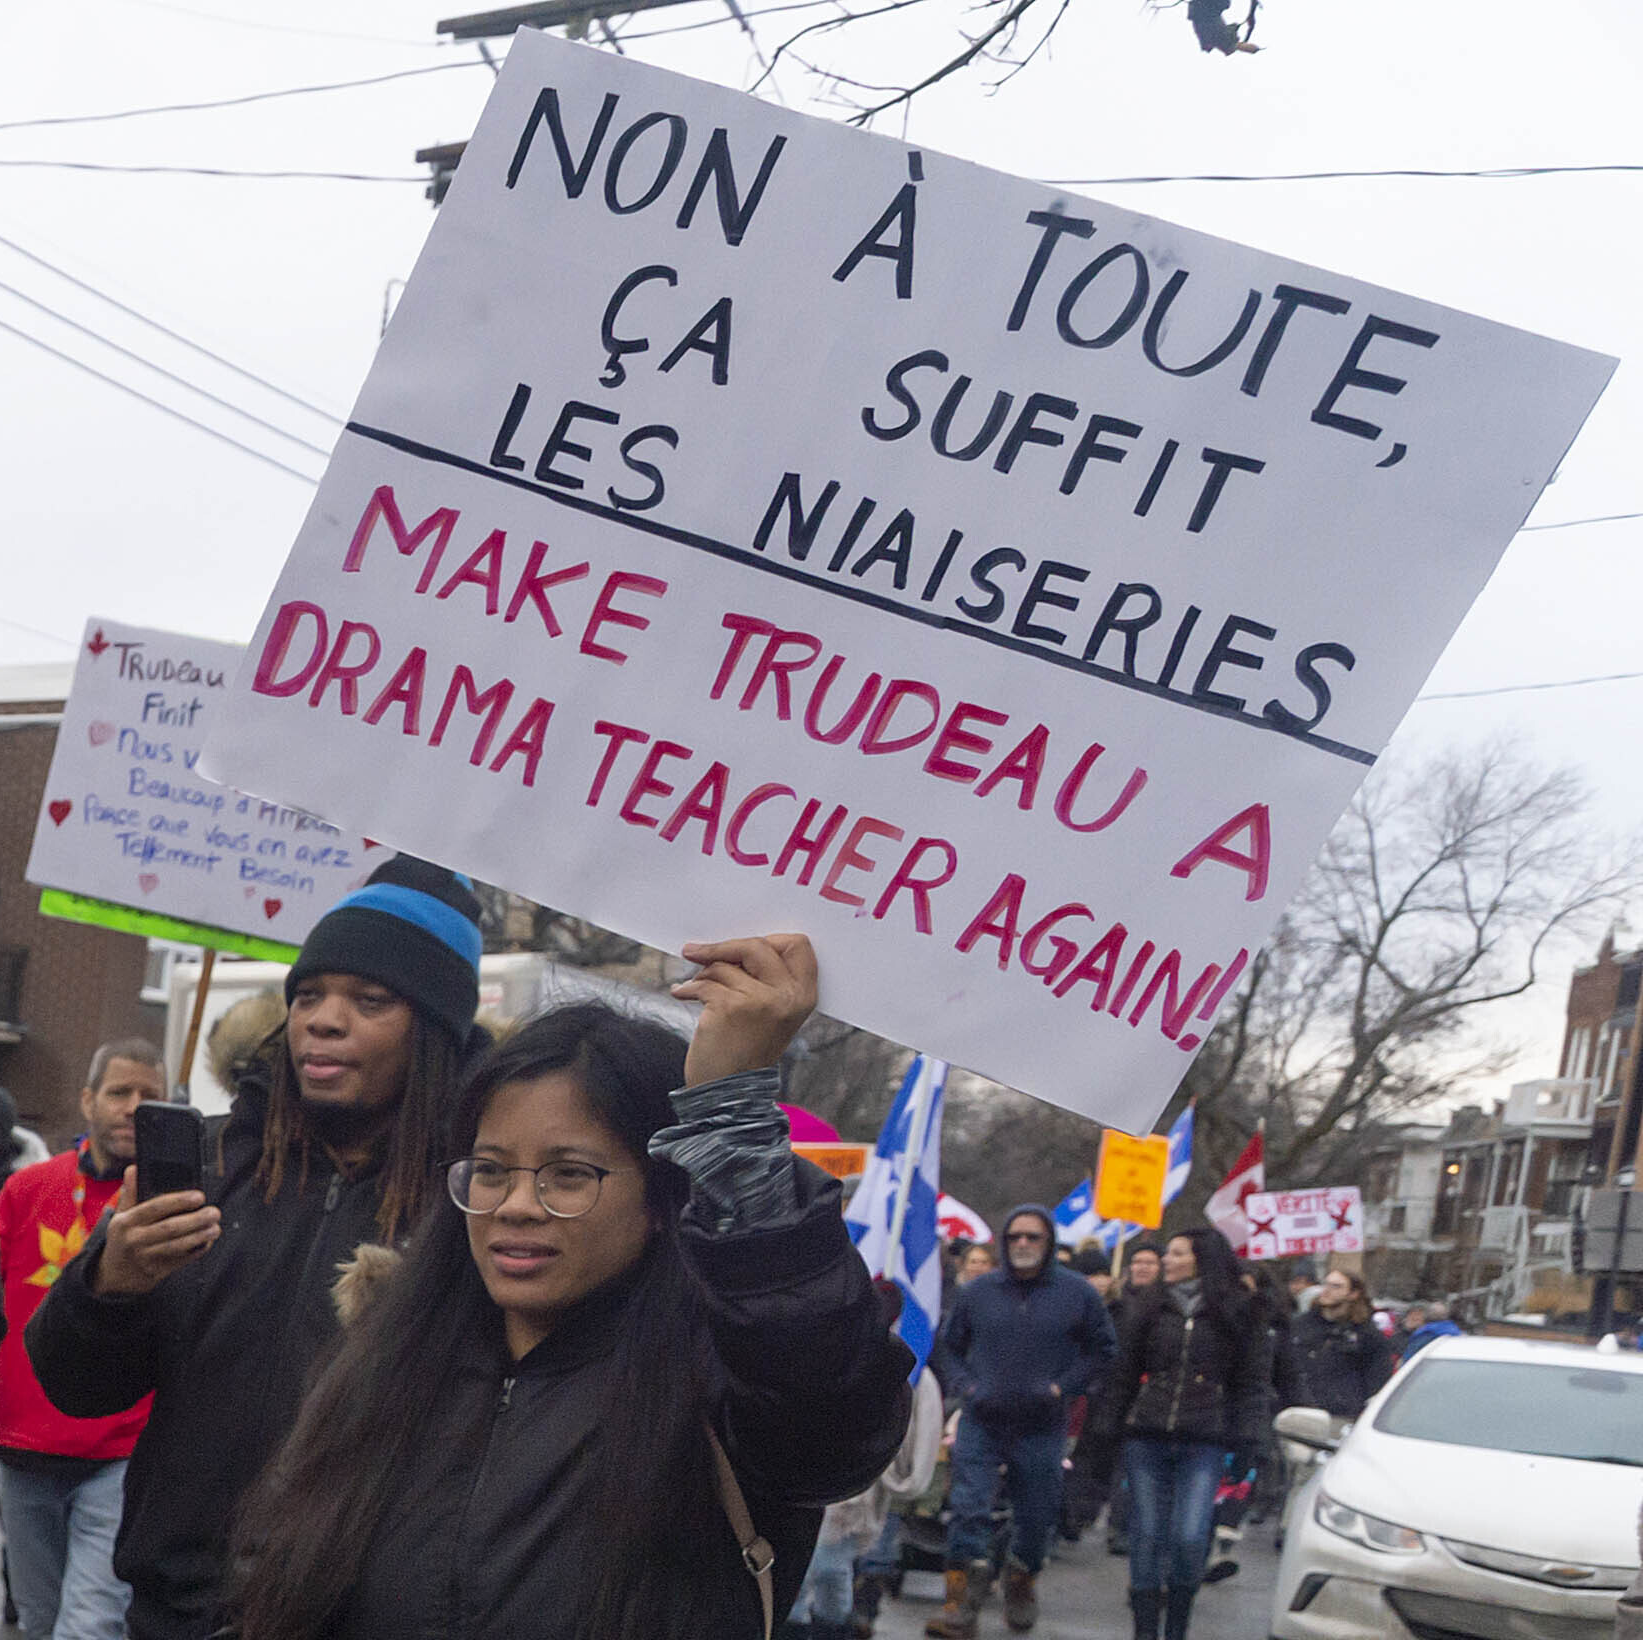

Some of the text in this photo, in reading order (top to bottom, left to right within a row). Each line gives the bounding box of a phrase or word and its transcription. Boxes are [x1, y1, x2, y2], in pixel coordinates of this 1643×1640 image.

[506, 86, 1440, 468] NON À TOUTE,
[599, 263, 1266, 533] ÇA SUFFIT
[342, 485, 1271, 902] MAKE TRUDEAU A
[490, 382, 1358, 735] LES NIAISERIES
[251, 600, 1249, 1052] DRAMA TEACHER AGAIN!
